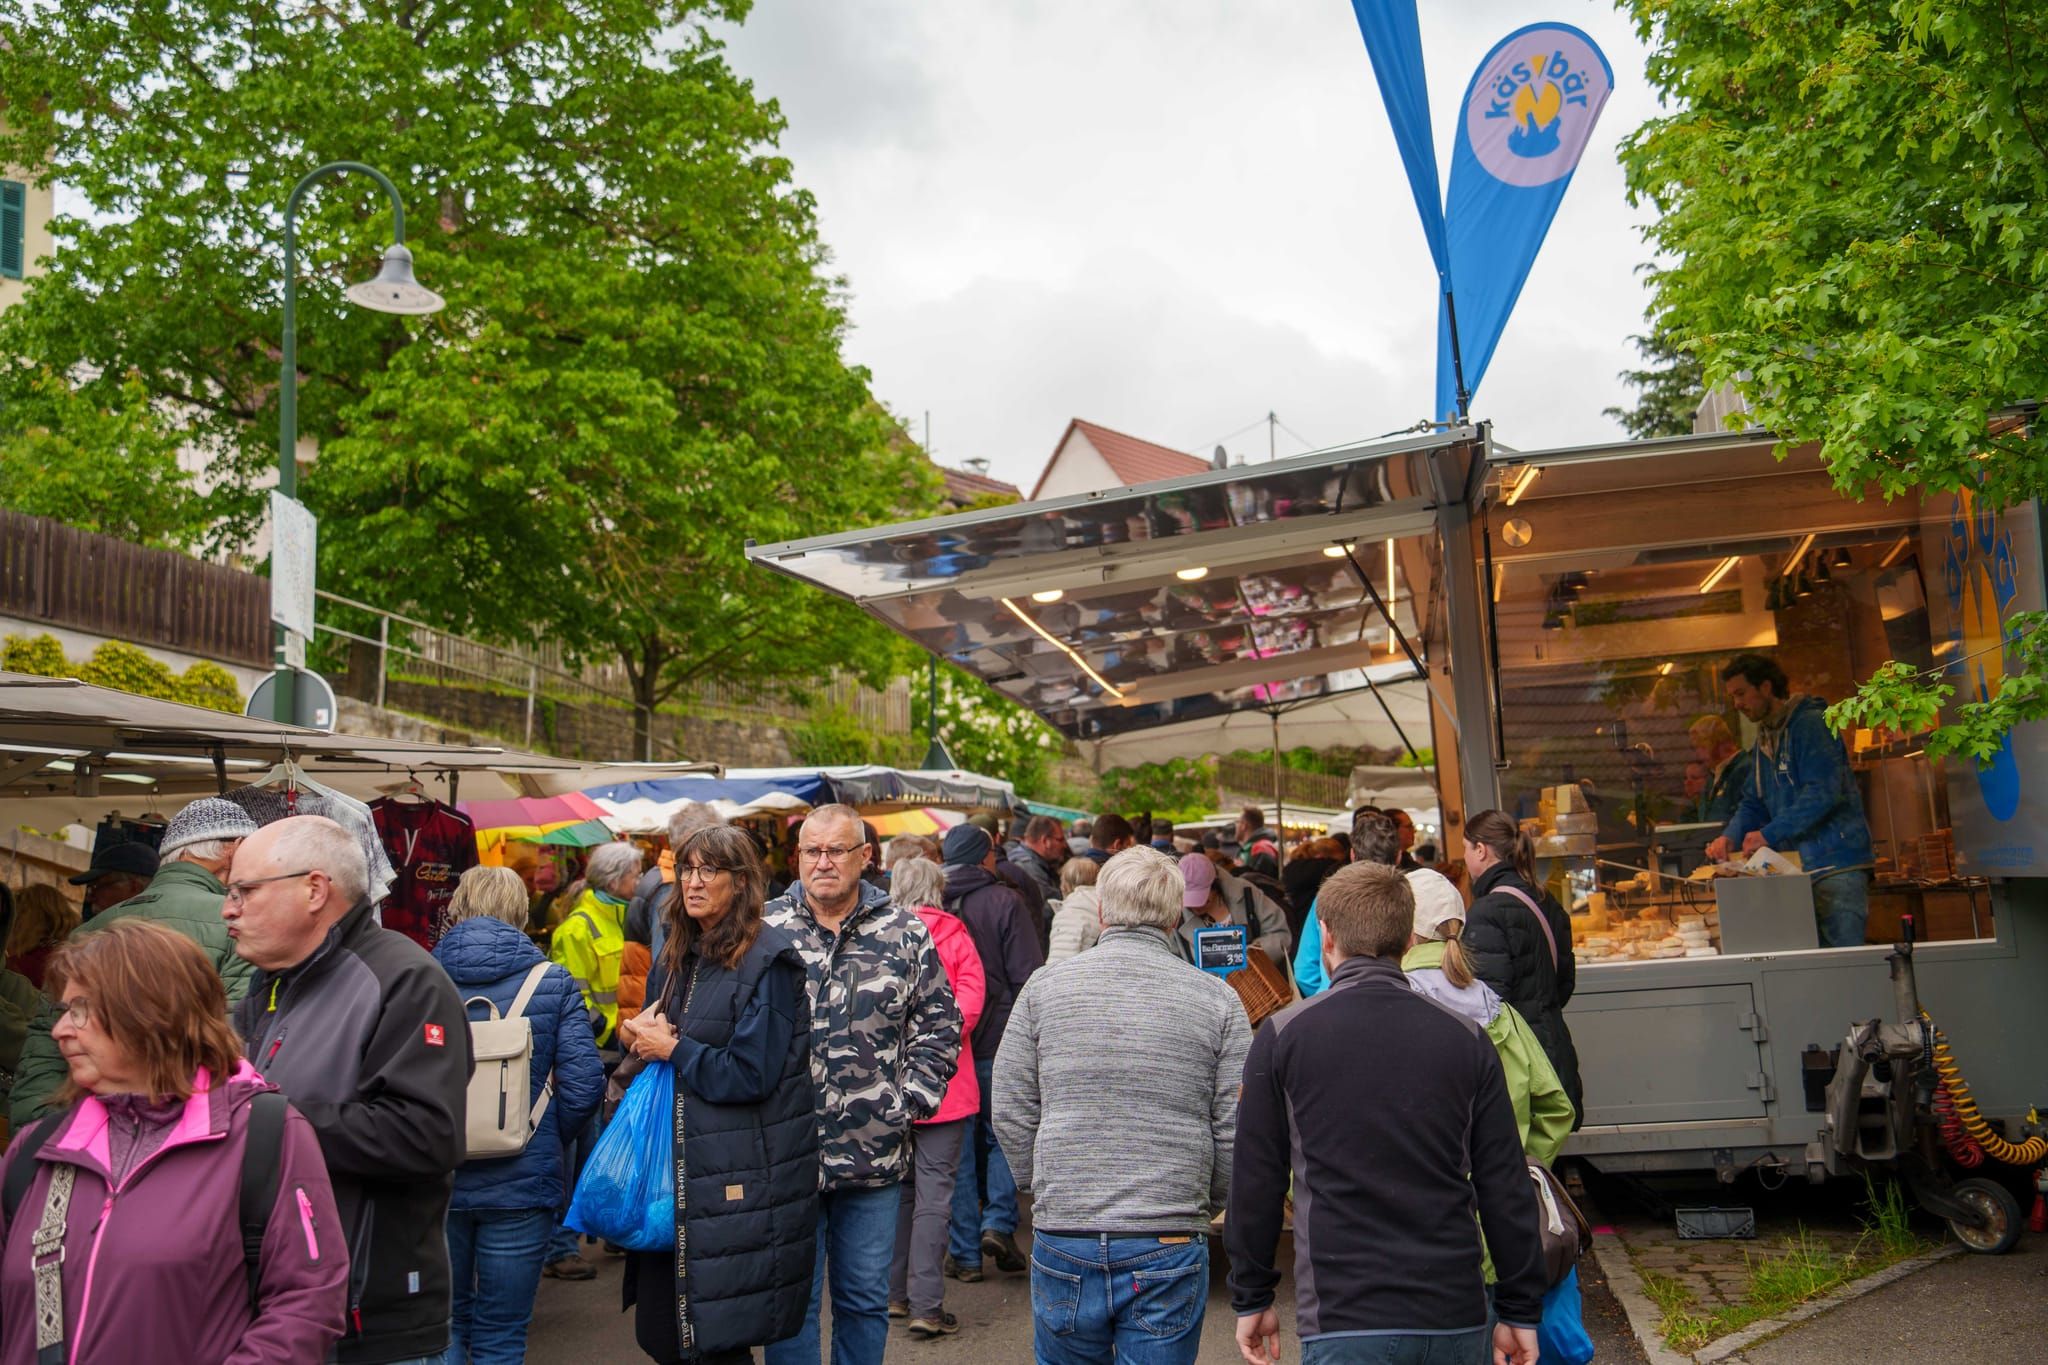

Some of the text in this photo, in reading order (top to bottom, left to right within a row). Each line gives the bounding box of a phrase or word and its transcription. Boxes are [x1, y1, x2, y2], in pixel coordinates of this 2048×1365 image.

[1484, 50, 1590, 119] käs bär
[676, 1093, 685, 1144] POLO CLUB
[677, 1159, 686, 1209] POLO CLUB
[677, 1225, 686, 1278] POLO CLUB
[679, 1294, 690, 1348] POLO CLUB
